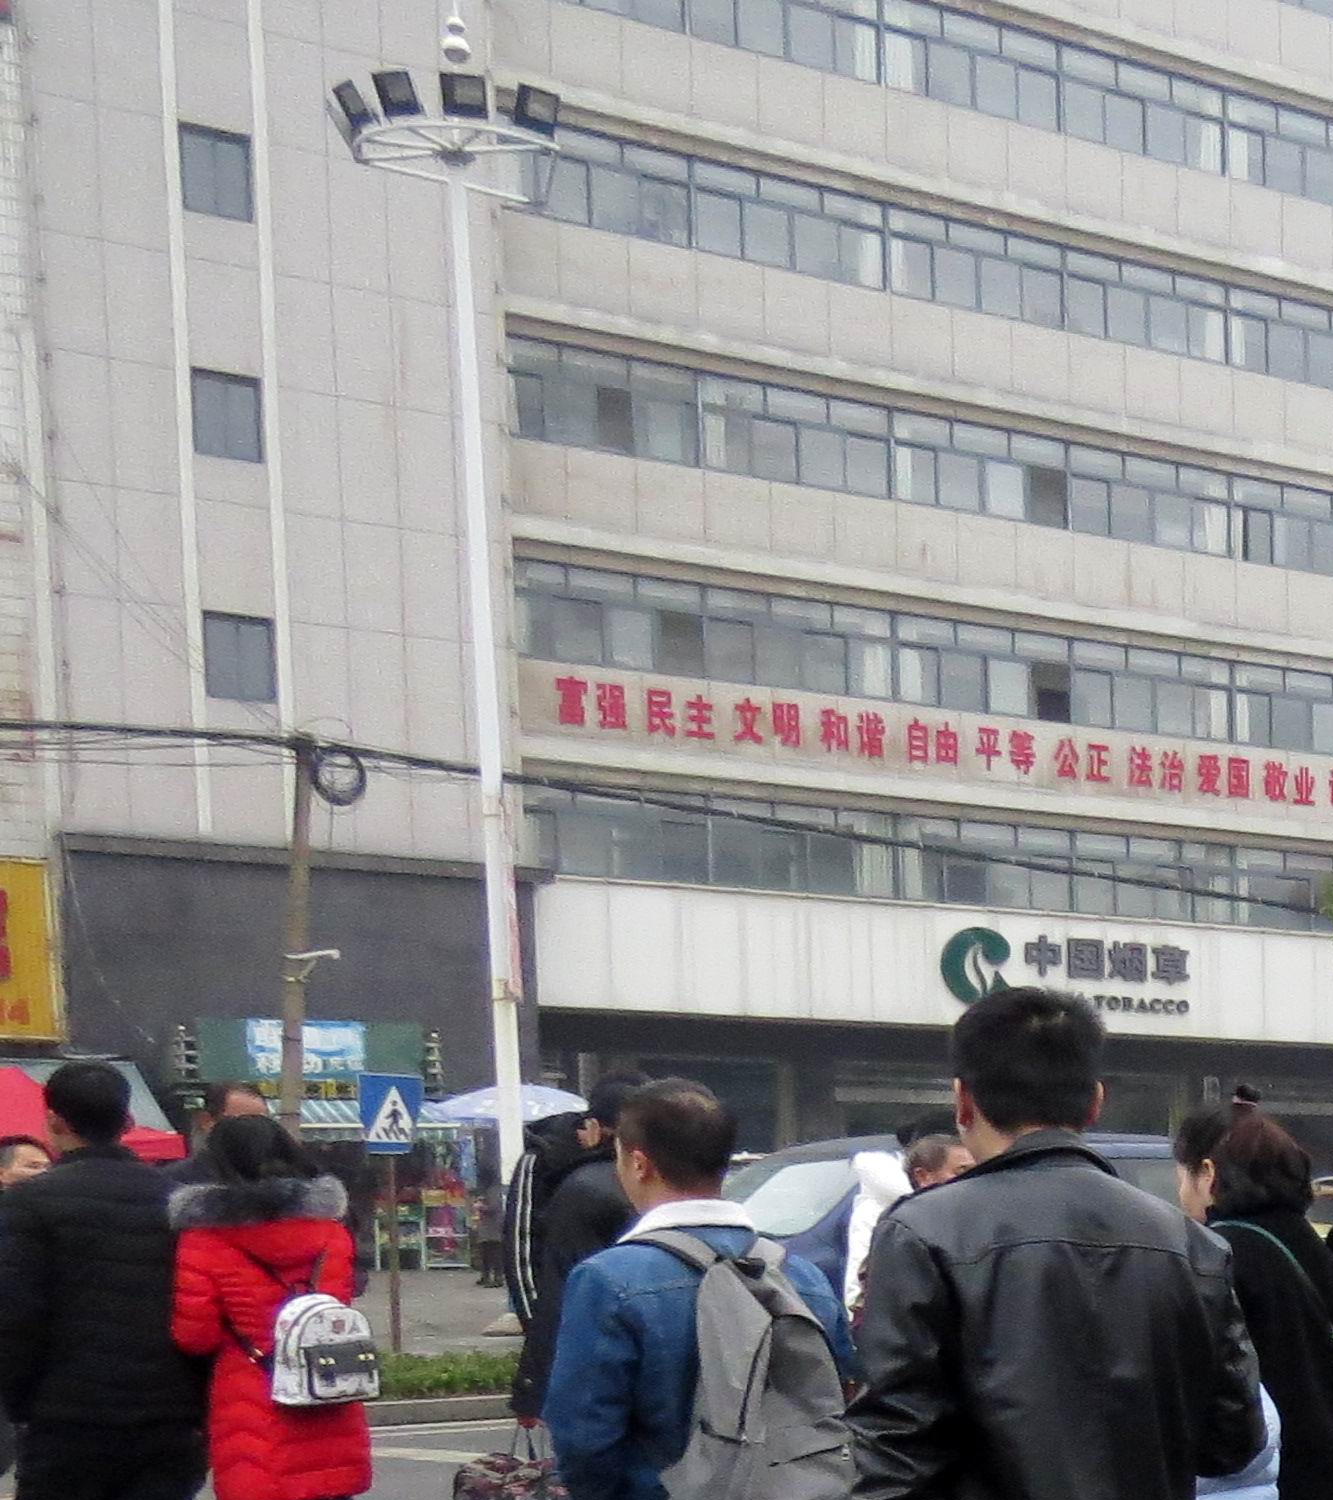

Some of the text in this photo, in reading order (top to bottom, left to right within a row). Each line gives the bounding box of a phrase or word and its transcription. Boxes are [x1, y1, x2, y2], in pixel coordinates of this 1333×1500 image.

[556, 676, 627, 730] 富强
[646, 689, 714, 740] 民主
[734, 697, 800, 748] 文明
[820, 707, 886, 759] 和谐
[907, 718, 958, 768] 自由
[975, 726, 1035, 775] 平等
[1054, 737, 1111, 784] 公正
[1129, 745, 1185, 795] 法治
[1198, 753, 1250, 799] 爱国
[1263, 761, 1316, 807] 敬业
[1024, 933, 1191, 985] 中国烟草
[1093, 994, 1190, 1015] TOBACCO
